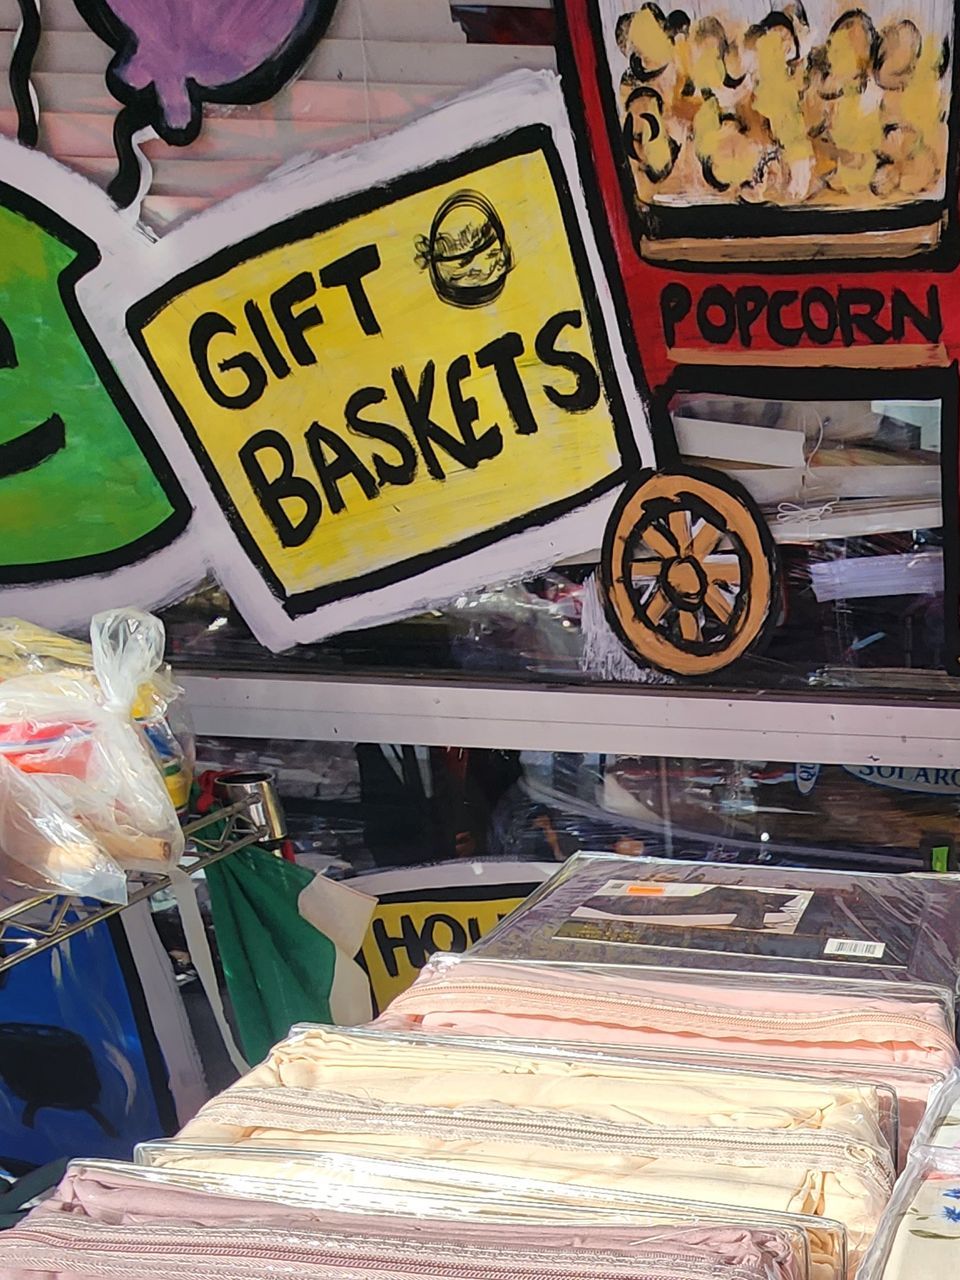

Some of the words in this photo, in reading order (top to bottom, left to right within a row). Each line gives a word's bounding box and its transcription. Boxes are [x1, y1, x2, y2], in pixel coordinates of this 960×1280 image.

[189, 245, 381, 409] GIFT
[659, 283, 942, 348] POPCORN
[239, 310, 602, 547] BASKETS
